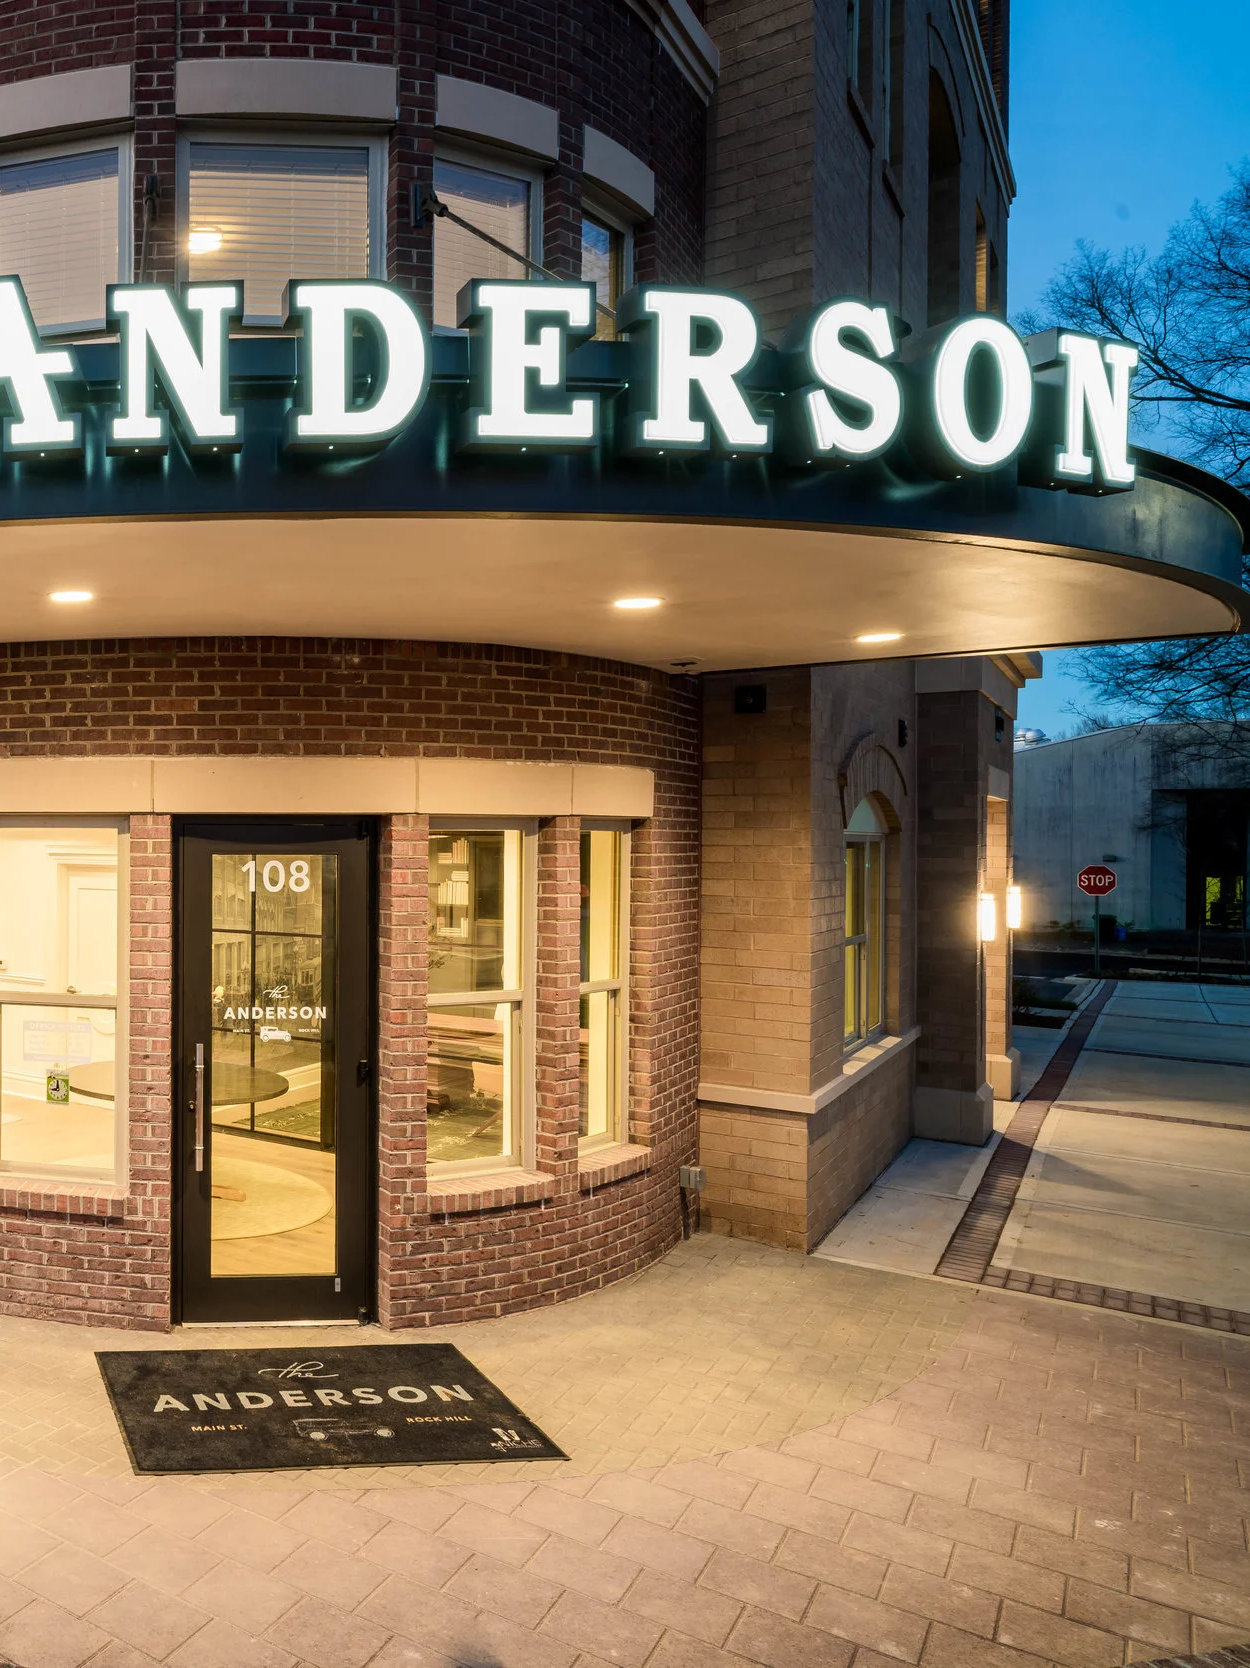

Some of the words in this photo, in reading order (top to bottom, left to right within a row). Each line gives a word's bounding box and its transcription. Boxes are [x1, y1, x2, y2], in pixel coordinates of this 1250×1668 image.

[241, 860, 311, 893] 108
[1080, 874, 1114, 887] STOP
[262, 985, 290, 999] the
[223, 1006, 327, 1020] ANDERSON
[258, 1361, 340, 1379] the
[153, 1383, 474, 1414] ANDERSON
